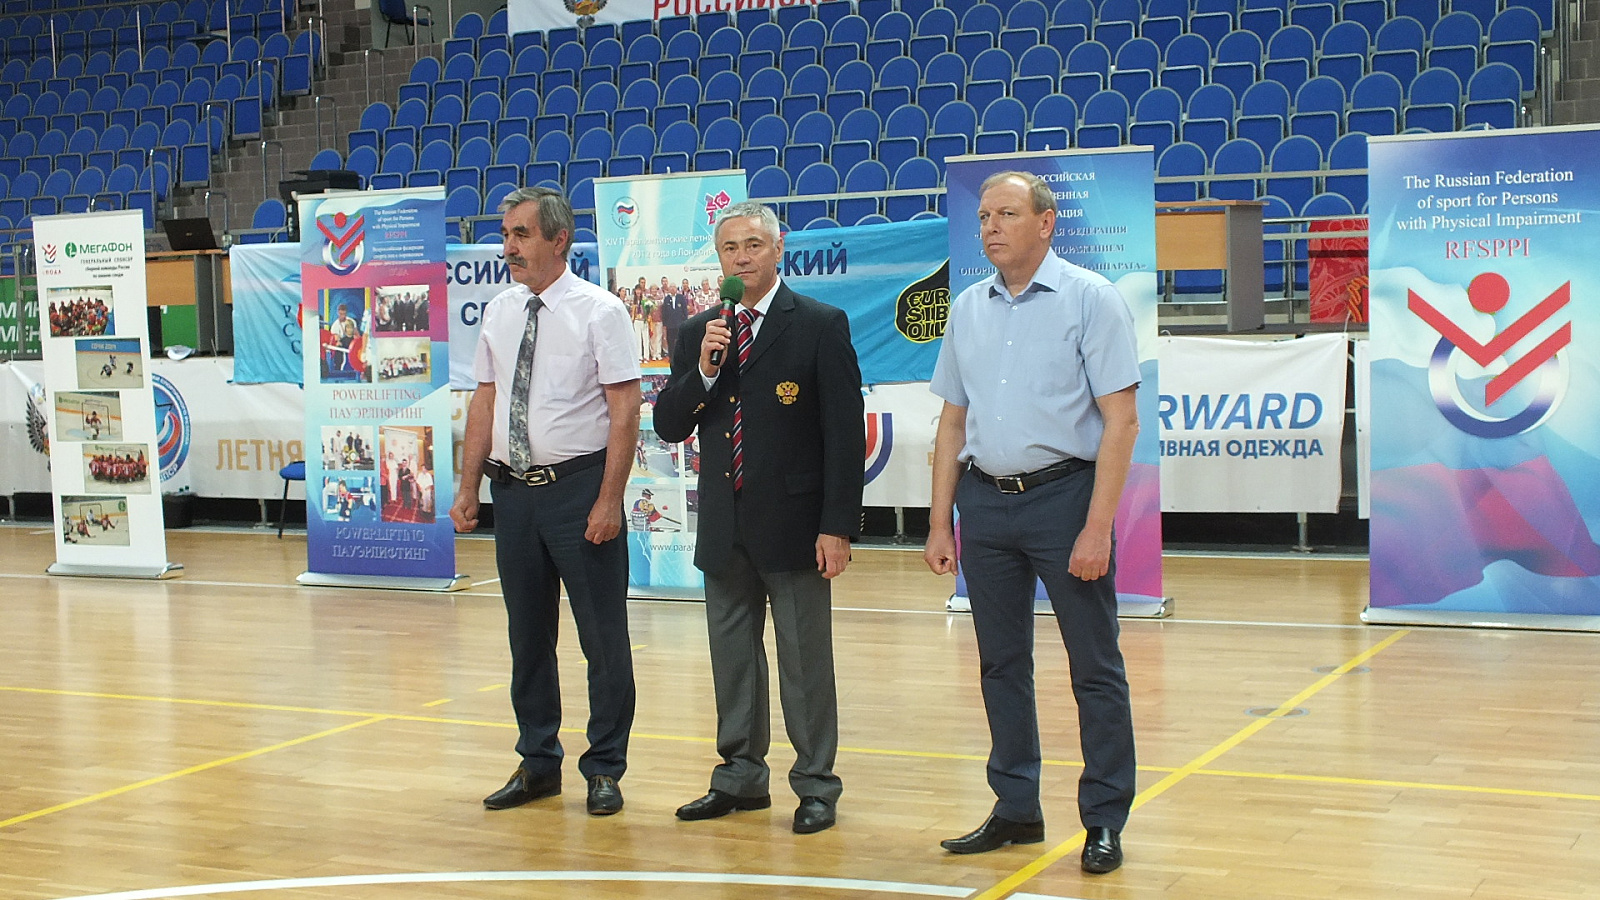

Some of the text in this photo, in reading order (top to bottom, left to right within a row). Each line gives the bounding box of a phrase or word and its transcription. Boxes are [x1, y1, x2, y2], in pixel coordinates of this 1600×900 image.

[1037, 172, 1096, 183] ОССИЙСКАЯ
[1403, 168, 1574, 189] The Russian Federation
[1052, 190, 1089, 200] ВЕННАЯ
[1417, 191, 1558, 211] of sport for Persons
[1056, 208, 1083, 219] АЦИЯ
[1397, 211, 1581, 232] with Physical Impairment
[1445, 237, 1531, 260] RFSPPI
[777, 241, 848, 277] КИЙ
[332, 388, 421, 401] POWERLIFTING
[329, 407, 425, 419] ПАУЭРЛИФТИНГ
[1226, 438, 1323, 459] ОДЕЖДА
[335, 526, 426, 543] POWERLIFTING
[332, 544, 429, 561] ПАУЭРЛИФТИНГ
[650, 543, 697, 554] www.paral
